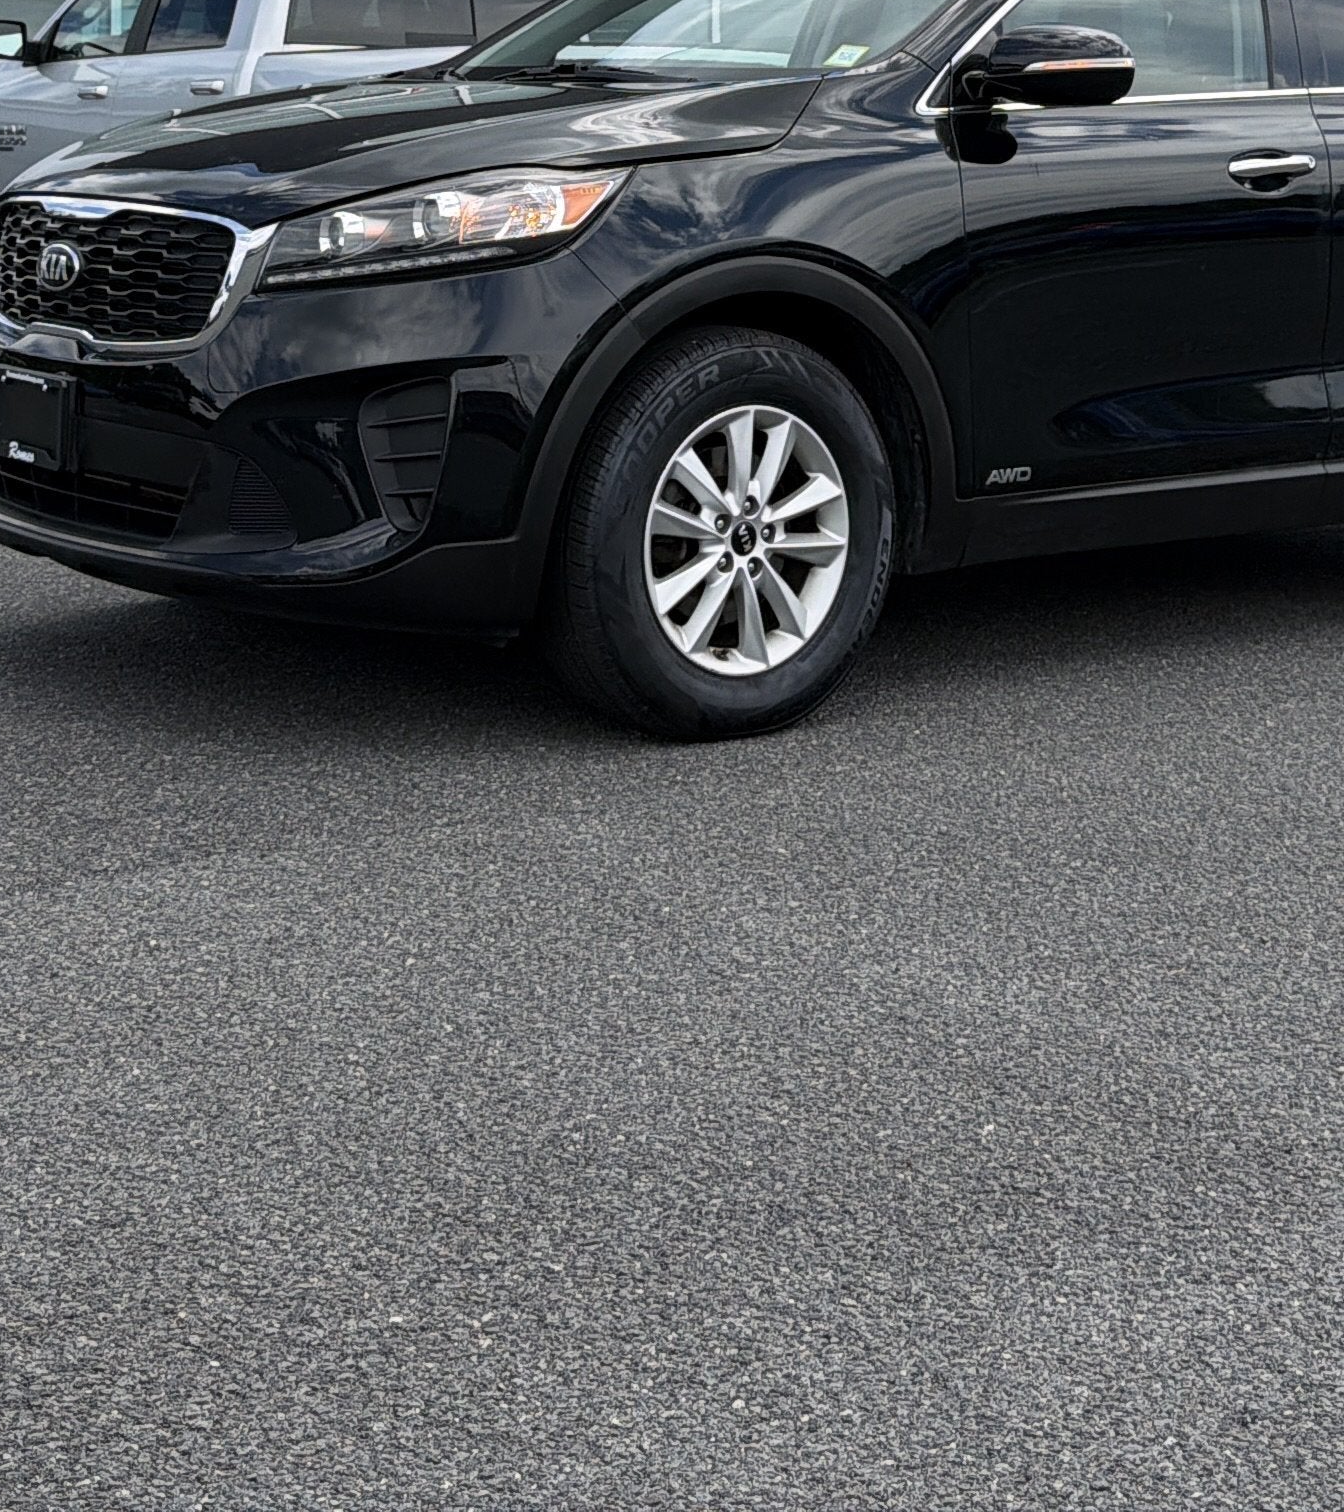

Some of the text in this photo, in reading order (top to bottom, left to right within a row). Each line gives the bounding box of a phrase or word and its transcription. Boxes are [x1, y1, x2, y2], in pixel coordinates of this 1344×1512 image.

[41, 253, 68, 280] KIA
[616, 364, 720, 500] OOPER
[985, 466, 1032, 486] AWD
